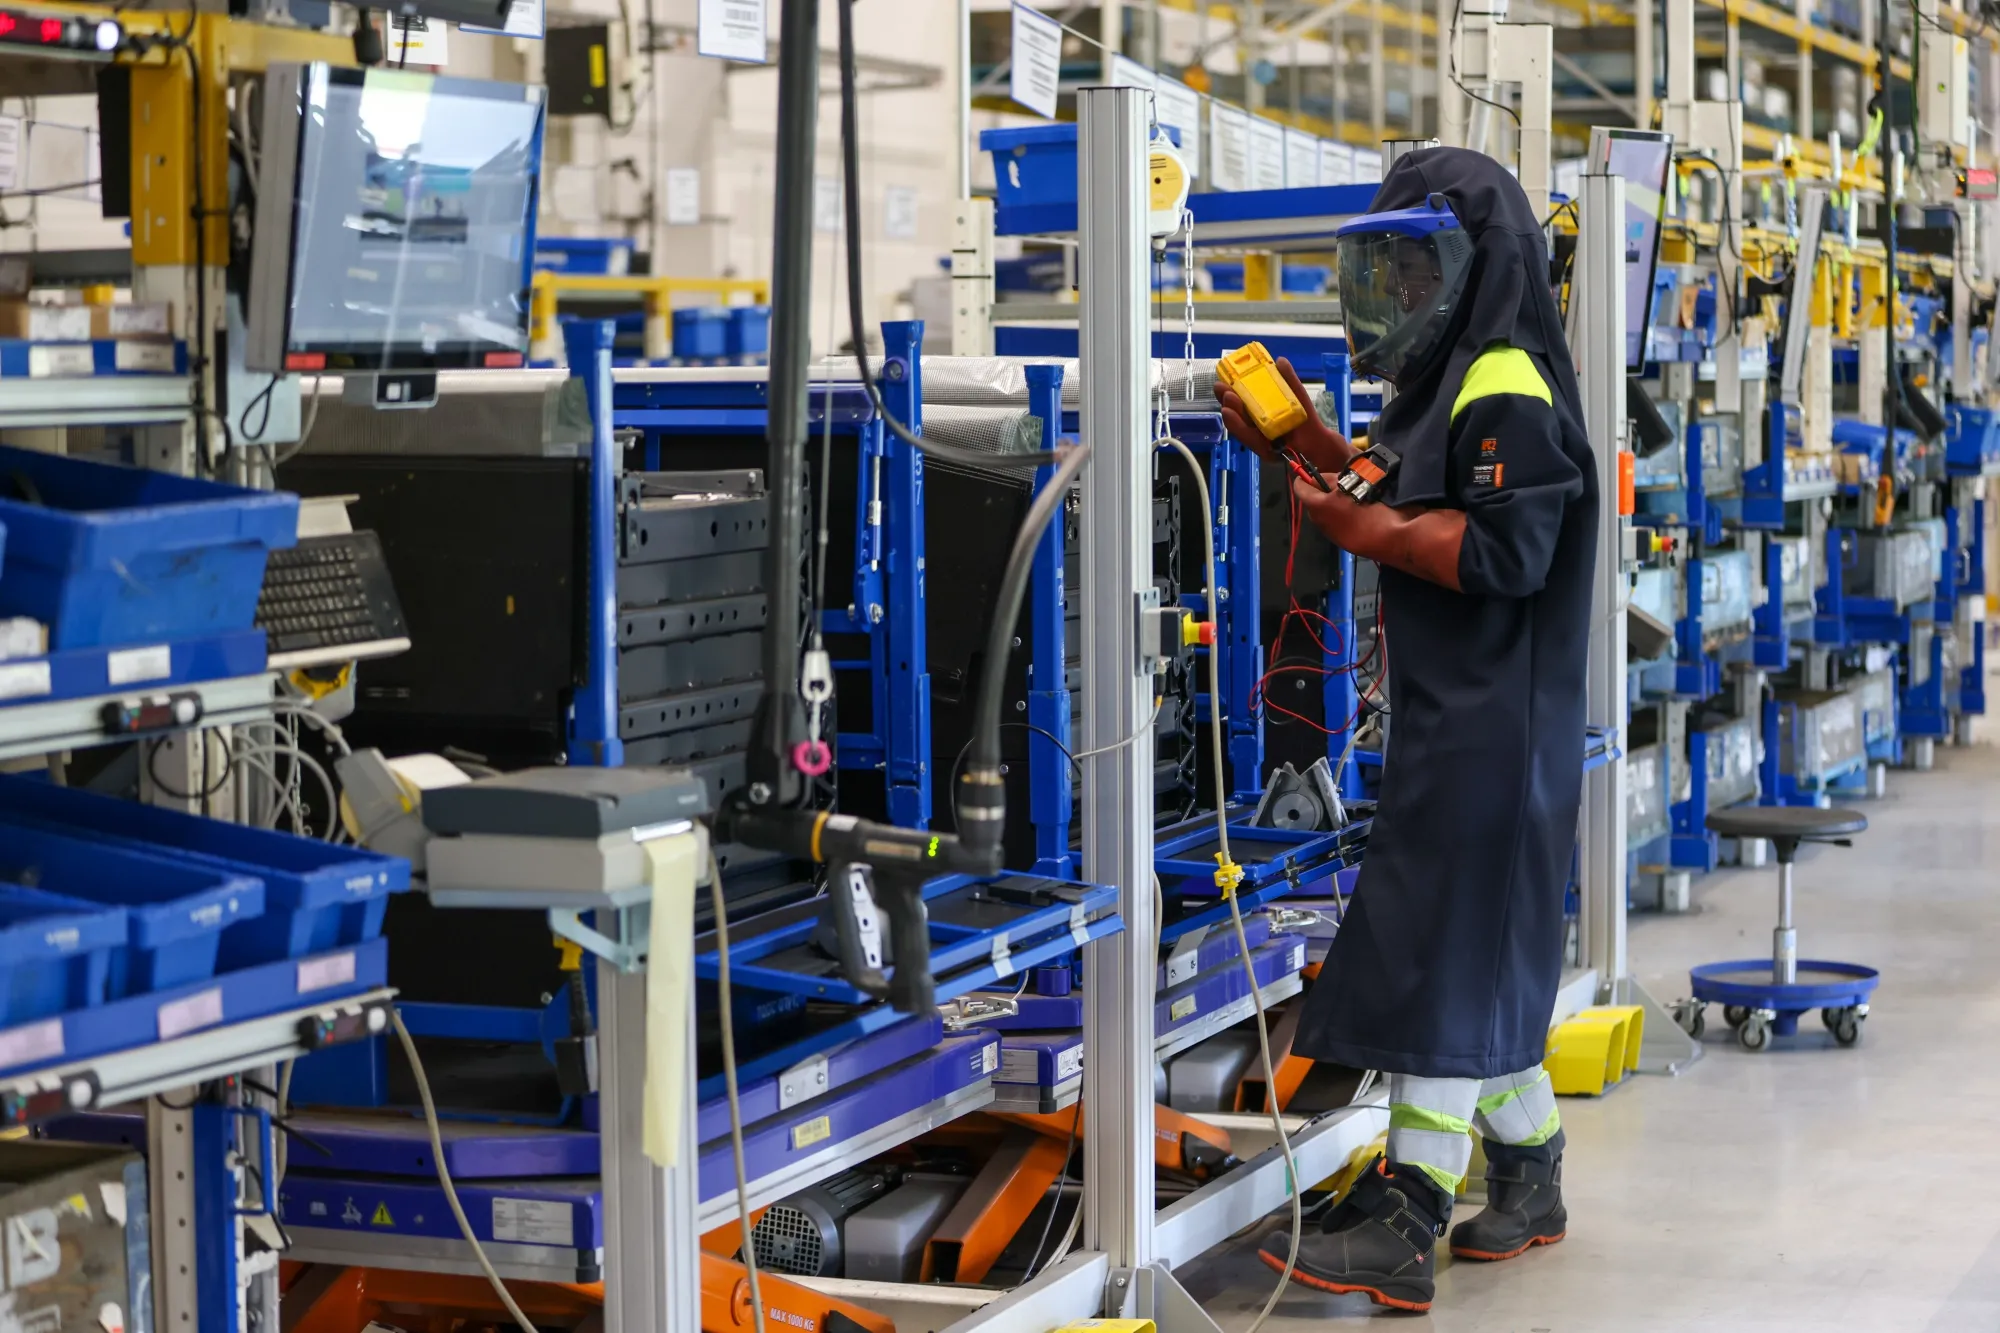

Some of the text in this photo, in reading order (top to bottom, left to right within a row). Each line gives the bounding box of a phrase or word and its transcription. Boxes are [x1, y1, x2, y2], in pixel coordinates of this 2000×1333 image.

[770, 1307, 814, 1331] MAX 1000 KG
